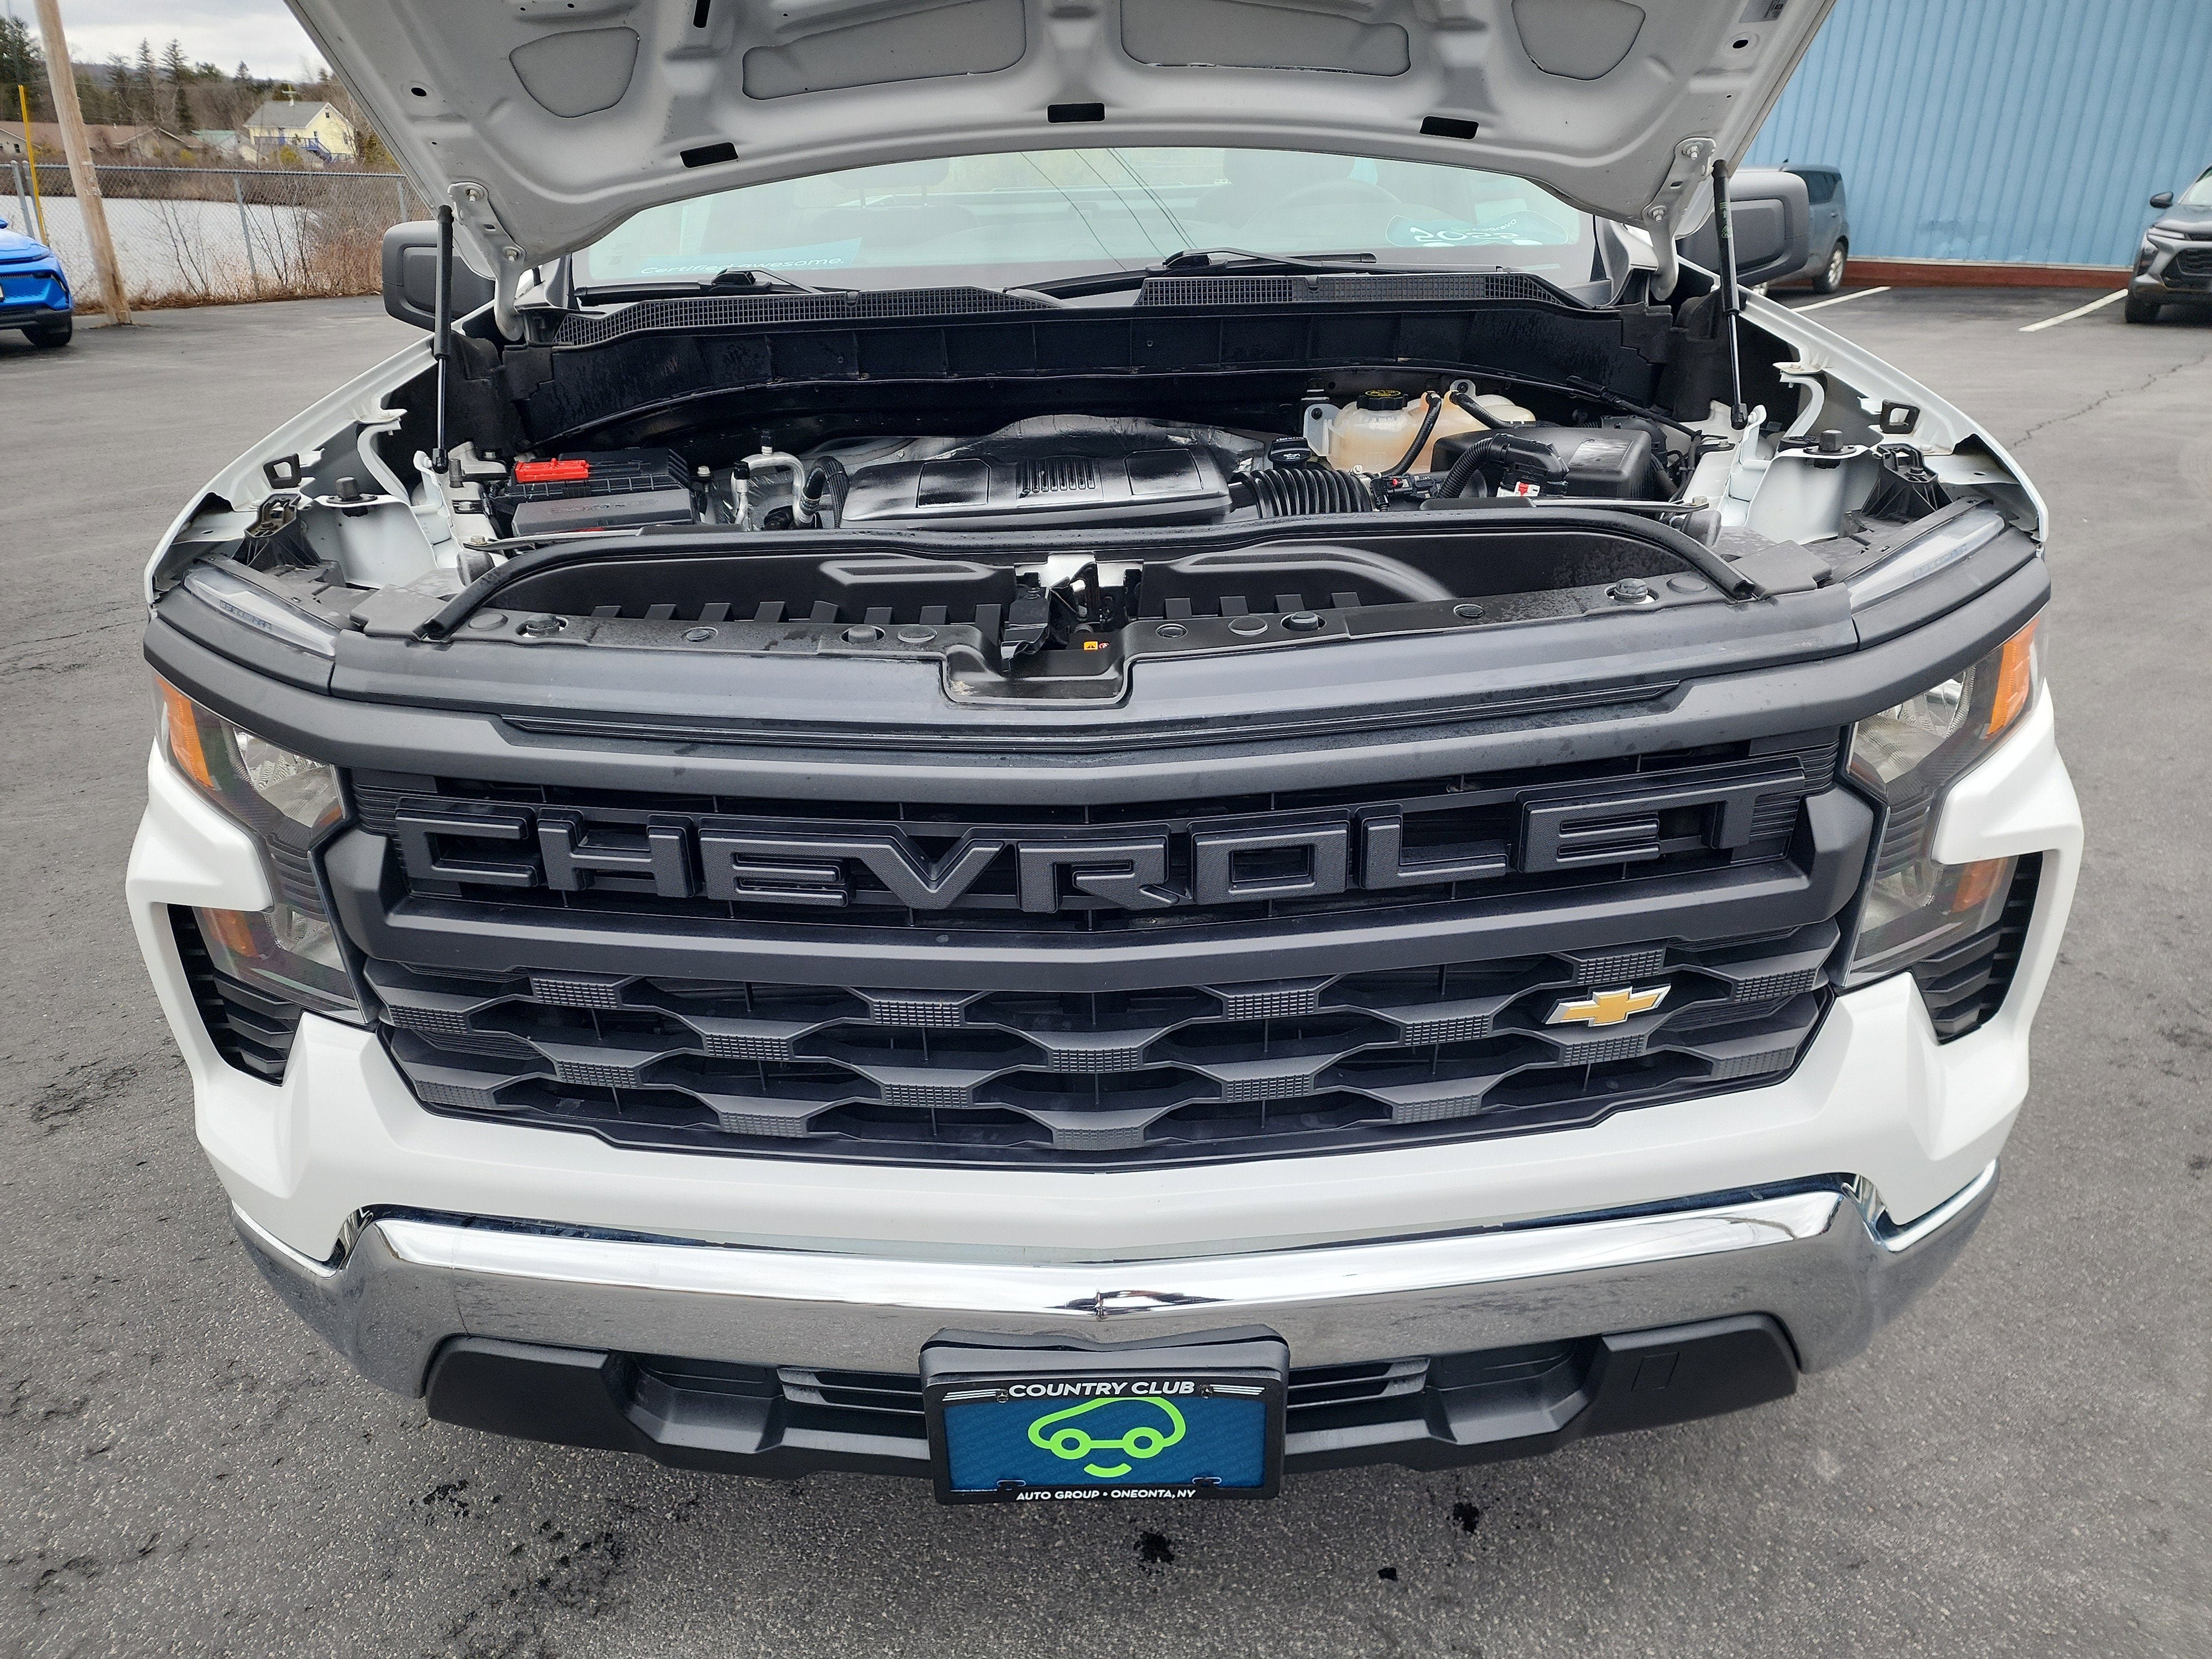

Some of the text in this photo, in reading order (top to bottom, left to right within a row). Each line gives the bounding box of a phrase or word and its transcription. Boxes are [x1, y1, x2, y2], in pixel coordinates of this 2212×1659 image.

[640, 263, 734, 274] Certified
[395, 763, 1805, 914] CHEVROLET
[1009, 1381, 1195, 1397] COUNTRY CLUB
[1016, 1491, 1051, 1500] AUTO
[1055, 1490, 1100, 1499] GROUP
[1177, 1489, 1196, 1498] NY
